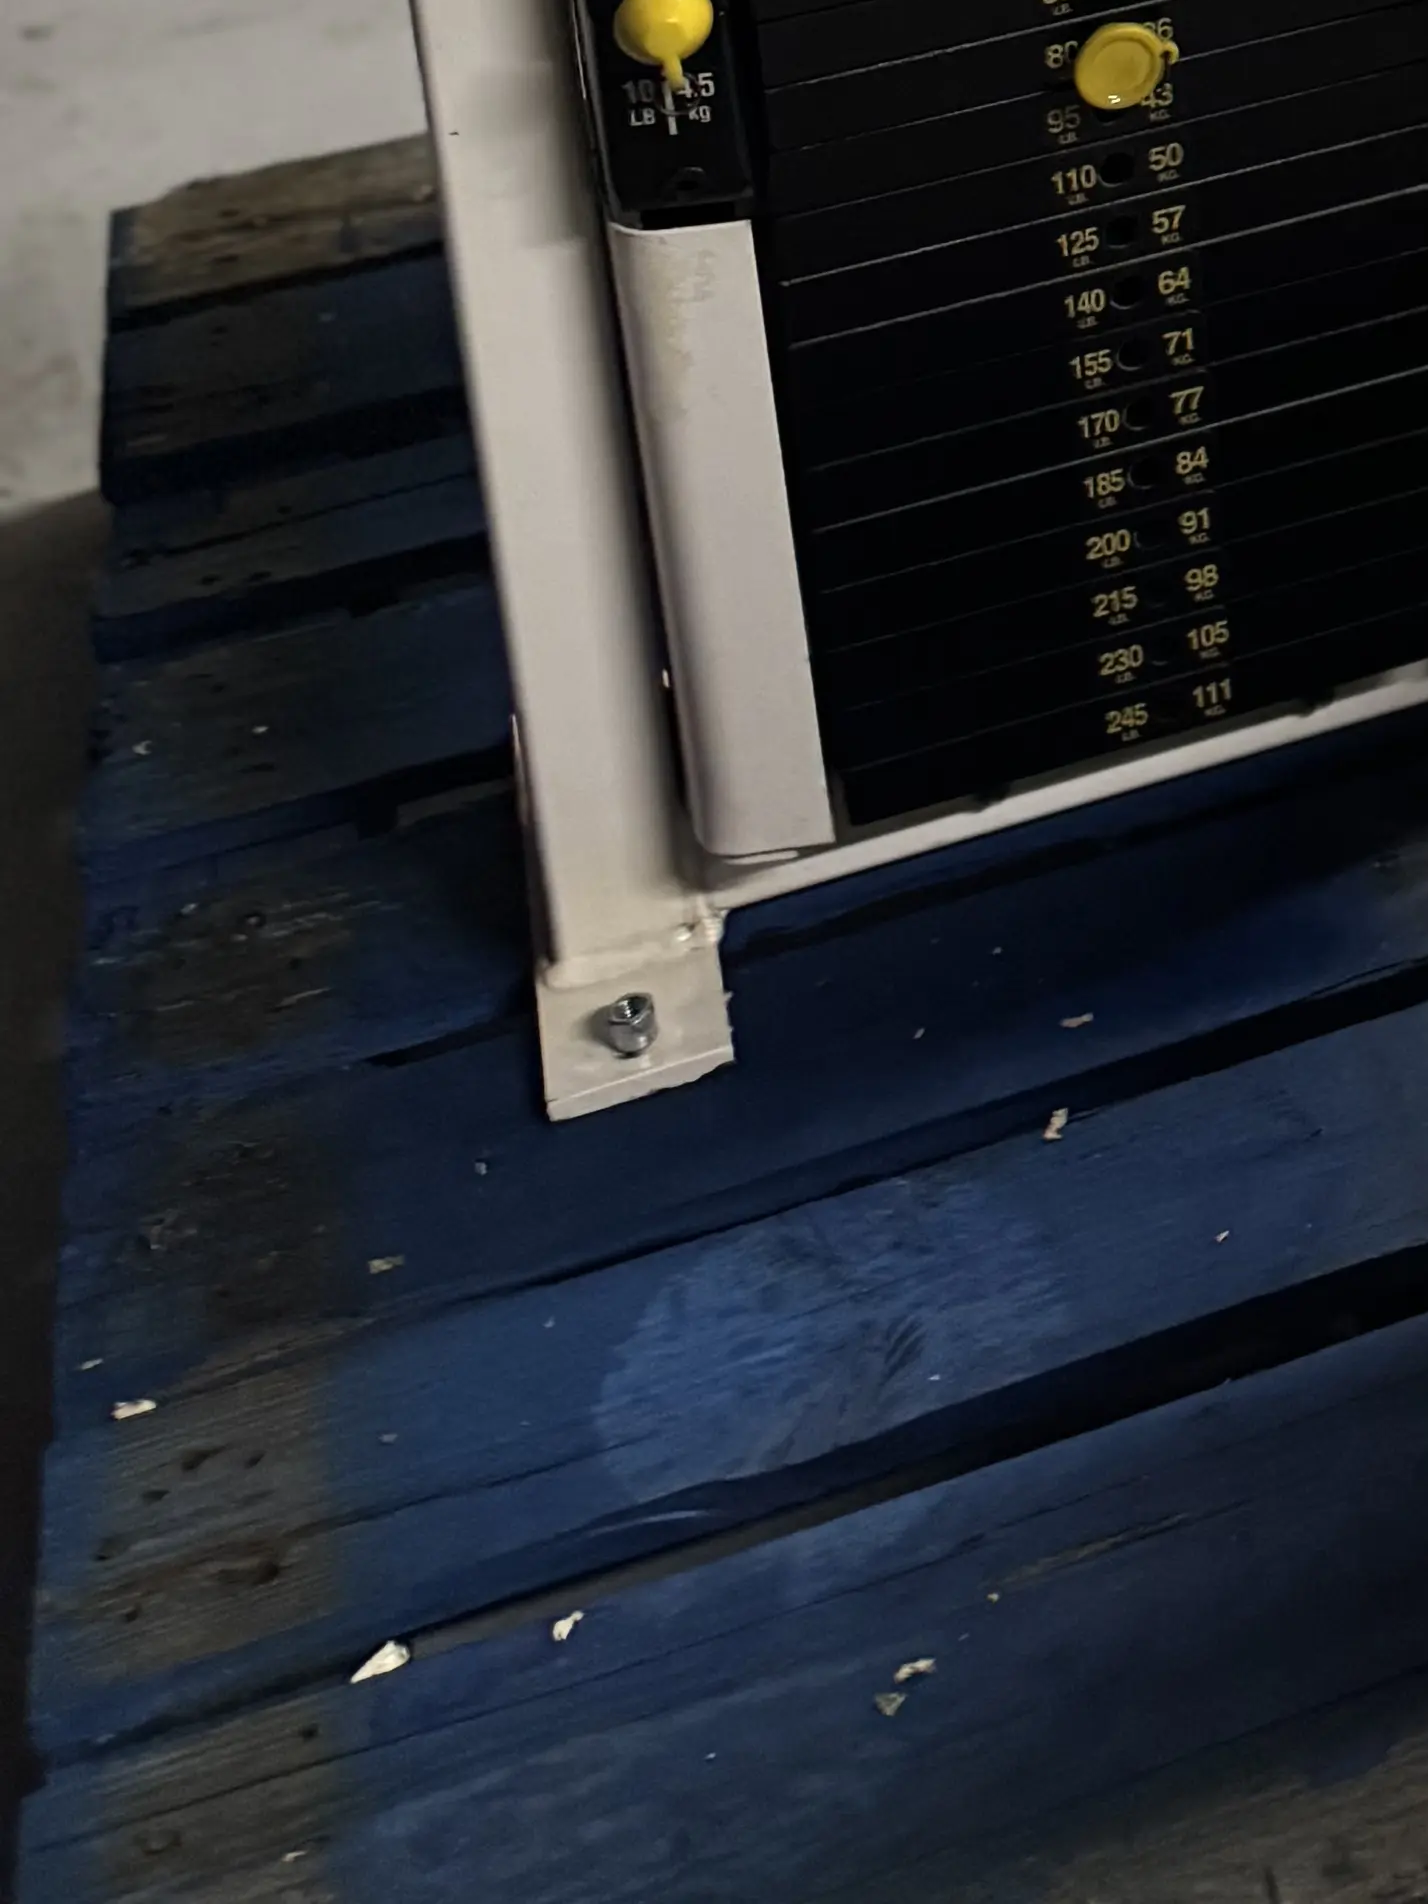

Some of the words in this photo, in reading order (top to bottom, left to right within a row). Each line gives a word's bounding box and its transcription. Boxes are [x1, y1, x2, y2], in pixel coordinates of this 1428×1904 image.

[622, 79, 655, 104] 10
[630, 108, 655, 126] LB
[688, 105, 712, 123] kg
[1047, 105, 1081, 134] 95
[1052, 164, 1097, 194] 110
[1148, 143, 1183, 171] 50
[1057, 227, 1100, 257] 125
[1151, 205, 1186, 234] 57
[1064, 289, 1106, 318] 140
[1158, 267, 1192, 295] 64
[1069, 349, 1112, 380] 155
[1162, 327, 1194, 356] 71
[1077, 409, 1120, 438] 170
[1169, 385, 1204, 414] 77
[1083, 469, 1126, 498] 185
[1175, 446, 1209, 475] 84
[1086, 529, 1131, 560] 200
[1178, 507, 1210, 534] 91
[1092, 586, 1138, 617] 215
[1184, 564, 1219, 592] 98
[1099, 644, 1143, 676] 230
[1187, 620, 1230, 650] 105
[1105, 703, 1149, 734] 245
[1193, 678, 1232, 708] 111
